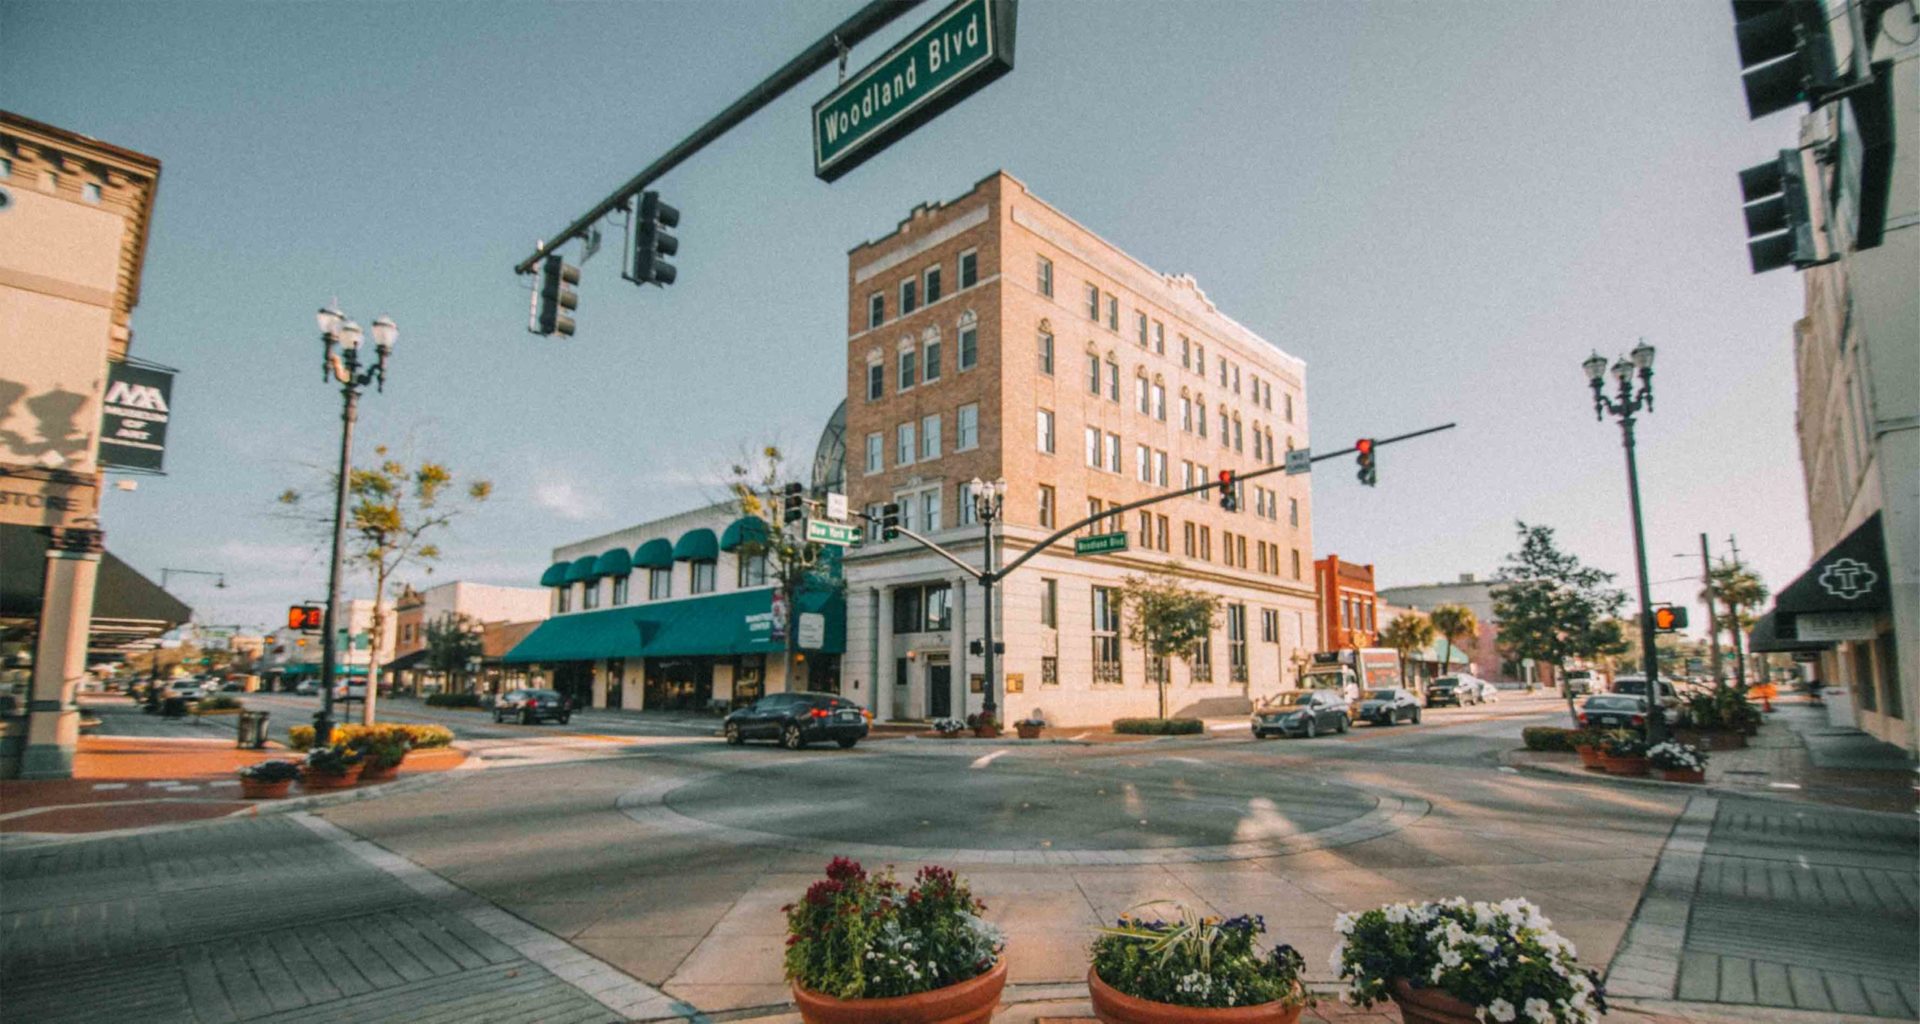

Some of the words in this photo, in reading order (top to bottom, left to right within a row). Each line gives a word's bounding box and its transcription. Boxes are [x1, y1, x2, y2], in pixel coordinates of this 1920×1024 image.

[824, 57, 917, 145] Woodland
[928, 13, 979, 74] Blvd
[1078, 539, 1108, 551] Woodland
